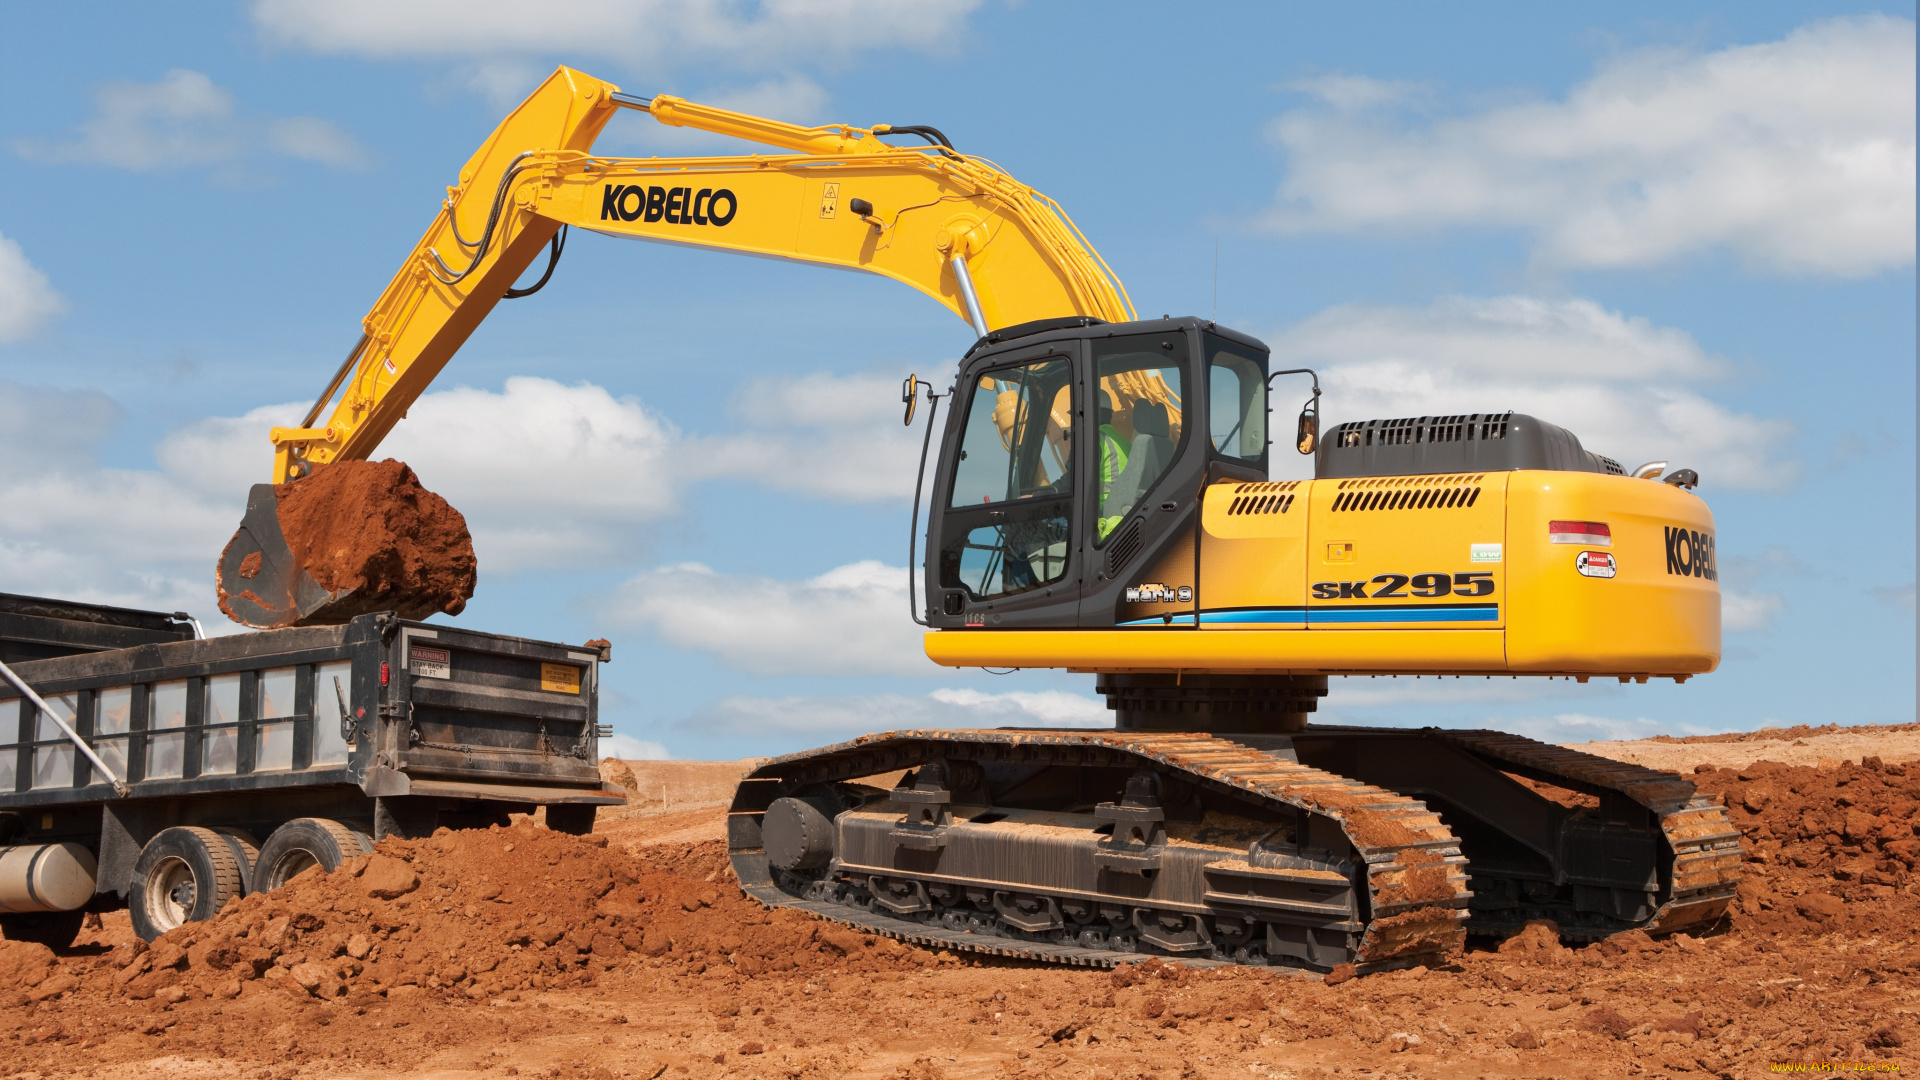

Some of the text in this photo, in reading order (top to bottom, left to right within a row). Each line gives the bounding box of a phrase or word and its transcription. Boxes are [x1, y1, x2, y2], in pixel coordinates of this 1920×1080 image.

[601, 184, 737, 227] KOBELCO
[1312, 571, 1495, 600] SK295
[1126, 586, 1193, 602] Mark 9
[411, 649, 445, 661] WARNING
[411, 660, 444, 670] STAY BACK
[418, 668, 428, 676] 100
